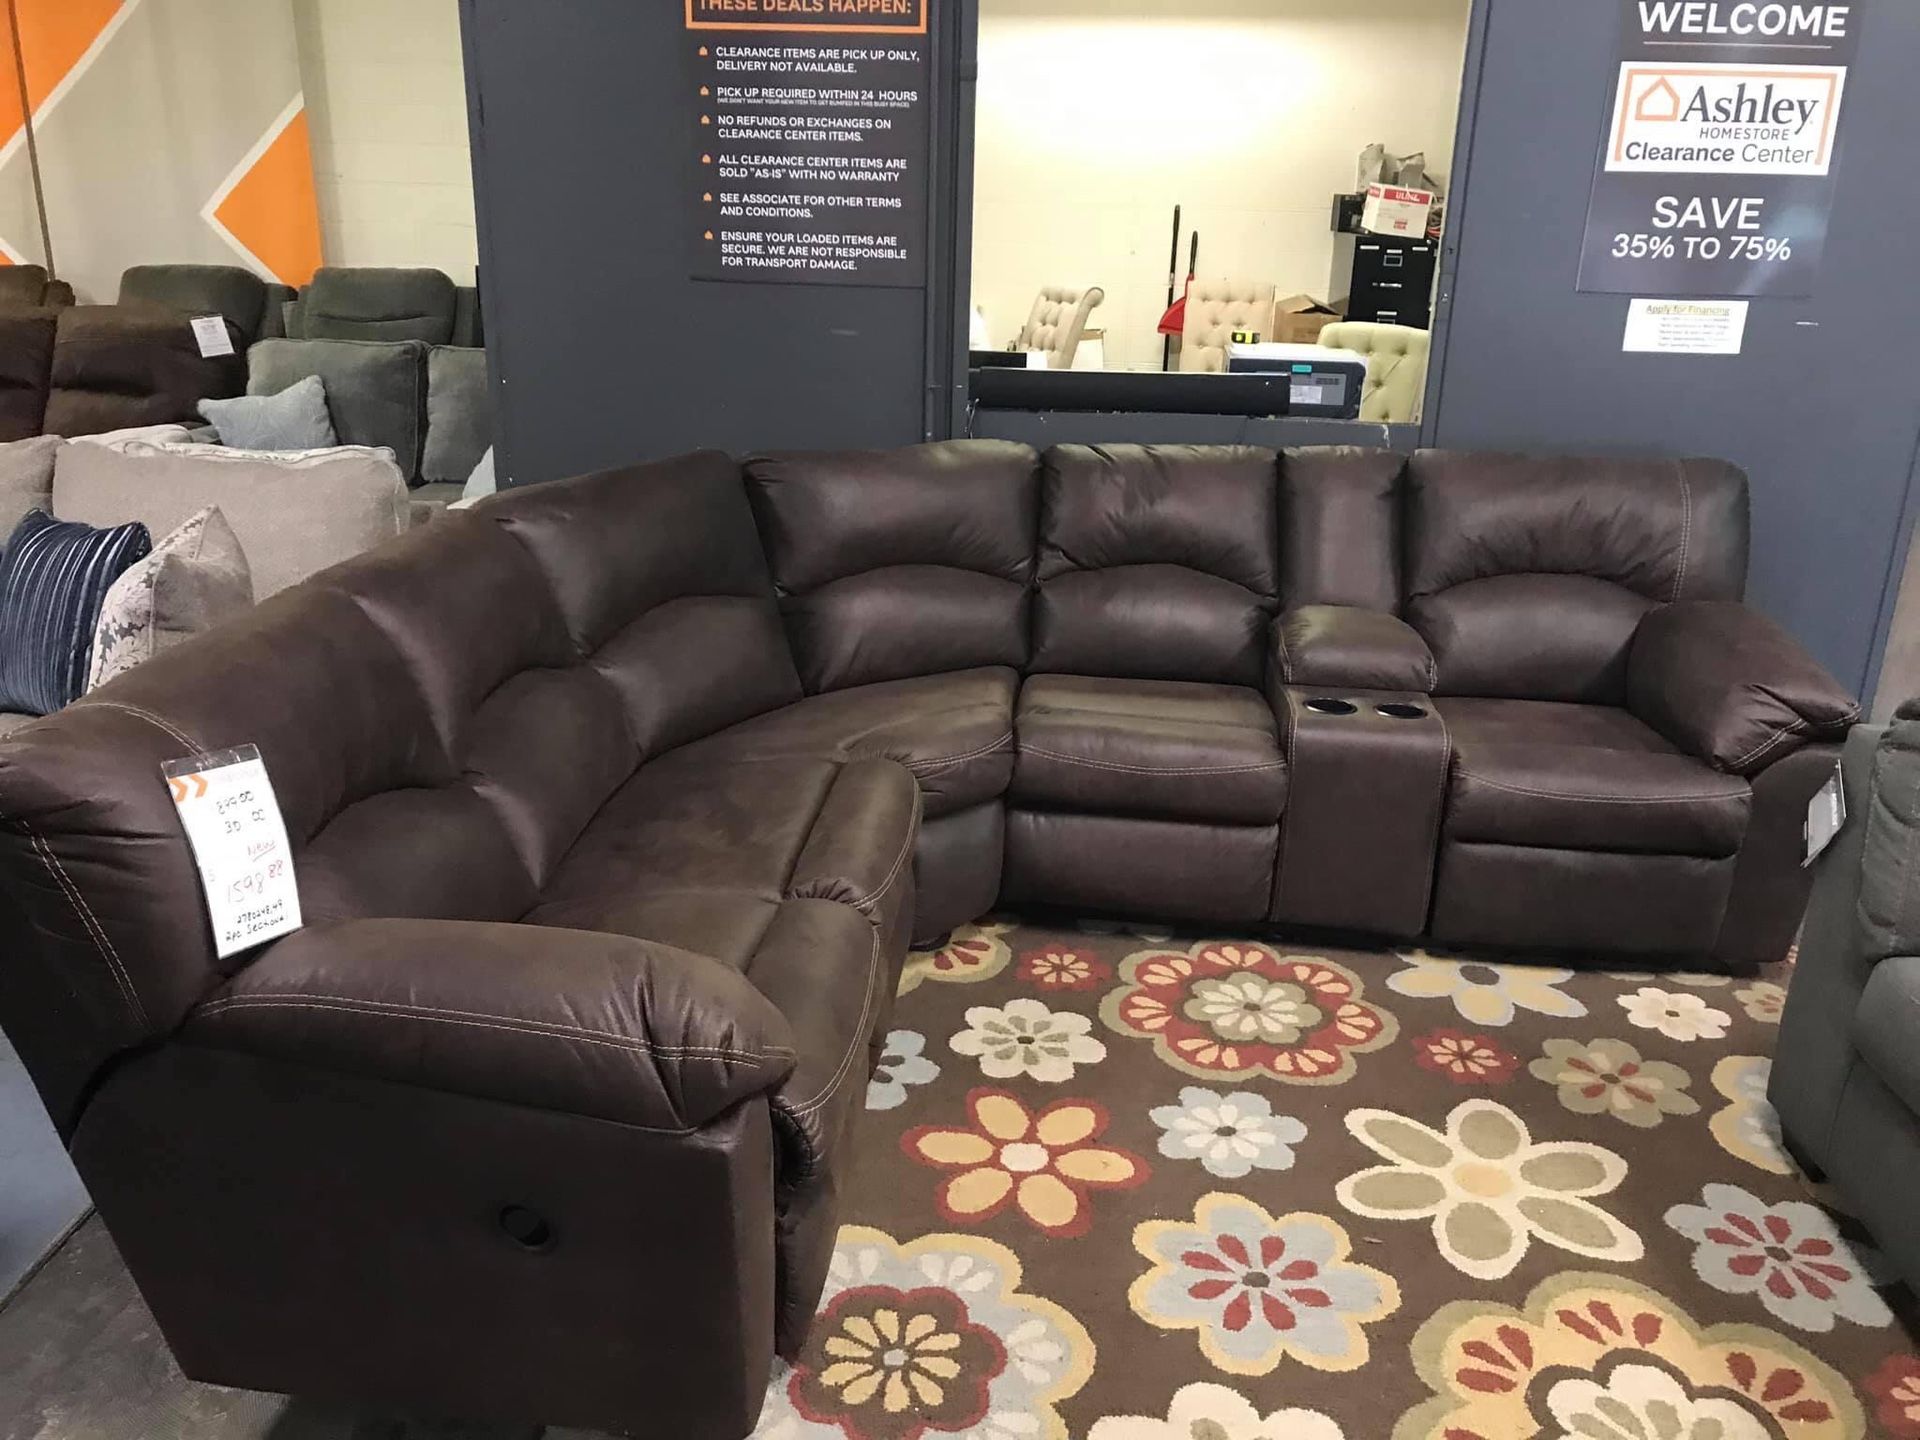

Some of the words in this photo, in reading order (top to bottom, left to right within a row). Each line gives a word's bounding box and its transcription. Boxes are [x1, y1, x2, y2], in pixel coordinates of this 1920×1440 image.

[763, 0, 824, 12] DEALS
[829, 0, 912, 14] HAPPEN:
[1638, 1, 1850, 37] WELCOME
[716, 47, 780, 58] CLEARANCE
[783, 49, 815, 59] ITEMS
[819, 50, 840, 60] ARE
[843, 50, 867, 60] PICK
[870, 51, 885, 60] UP
[888, 51, 919, 62] ONLY,
[717, 61, 768, 71] DELIVERY
[770, 62, 792, 72] NOT
[795, 63, 857, 73] AVAILABLE.
[717, 87, 741, 97] PICK
[744, 88, 759, 98] UP
[761, 88, 816, 100] REQUIRED
[819, 89, 858, 100] WITHIN
[861, 90, 874, 101] 24
[879, 91, 918, 101] HOURS
[1680, 82, 1819, 135] Ashley
[718, 116, 734, 126] NO
[737, 116, 786, 127] REFUNDS
[789, 118, 804, 127] OR
[807, 118, 872, 129] EXCHANGES
[875, 119, 891, 129] ON
[718, 129, 782, 140] CLEARANCE
[785, 130, 826, 141] CENTER
[829, 131, 863, 142] ITEMS.
[1700, 127, 1790, 141] HOMESTORE
[1625, 142, 1734, 162] Clearance
[1742, 143, 1813, 163] Center
[719, 155, 739, 165] ALL
[741, 155, 804, 166] CLEARANCE
[807, 157, 848, 167] CENTER
[851, 158, 883, 168] ITEMS
[885, 159, 907, 169] ARE
[719, 168, 748, 178] SOLD
[789, 169, 818, 179] WITH
[820, 170, 836, 180] NO
[839, 171, 899, 181] WARRANTY
[720, 194, 740, 203] SEE
[742, 194, 801, 205] ASSOCIATE
[803, 196, 825, 205] FOR
[827, 196, 863, 207] OTHER
[865, 198, 902, 208] TERMS
[720, 207, 743, 216] AND
[745, 207, 813, 218] CONDITIONS.
[1652, 196, 1765, 229] SAVE
[721, 231, 763, 241] ENSURE
[765, 233, 794, 242] YOUR
[797, 233, 840, 244] LOADED
[842, 235, 874, 245] ITEMS
[876, 236, 897, 245] ARE
[721, 244, 766, 254] SECURE.
[768, 246, 785, 255] WE
[788, 246, 809, 256] ARE
[811, 247, 833, 257] NOT
[835, 248, 907, 259] RESPONSIBLE
[1612, 233, 1675, 259] 35%
[1683, 237, 1720, 259] TO
[1728, 236, 1792, 261] 75%
[722, 257, 743, 266] FOR
[745, 258, 807, 268] TRANSPORT
[810, 259, 857, 270] DAMAGE.
